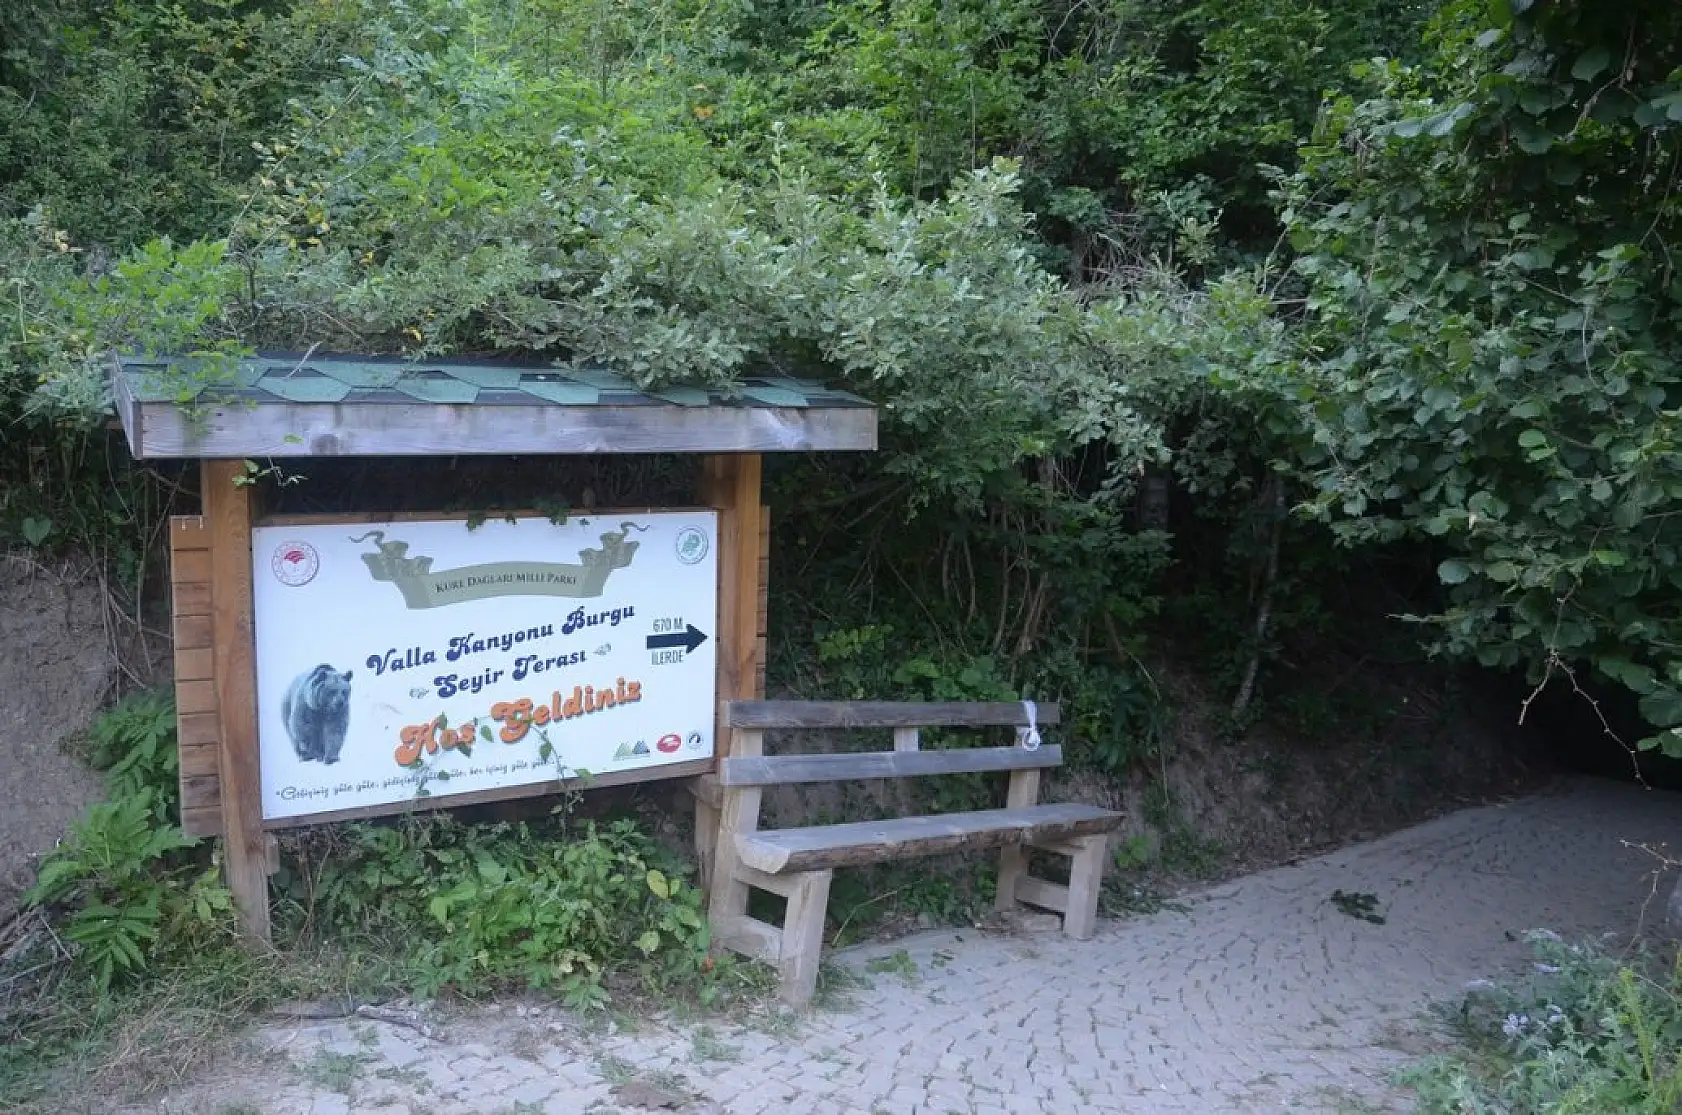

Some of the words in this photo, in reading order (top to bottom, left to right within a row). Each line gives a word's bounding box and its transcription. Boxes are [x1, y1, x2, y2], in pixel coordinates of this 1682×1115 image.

[366, 646, 438, 676] Valla
[445, 631, 554, 662] Kanyonu
[561, 605, 636, 635] Burgu
[653, 617, 672, 632] 670
[674, 616, 684, 630] M
[433, 667, 505, 699] Seyir
[511, 650, 588, 681] Terası
[491, 677, 642, 744] Geldiniz
